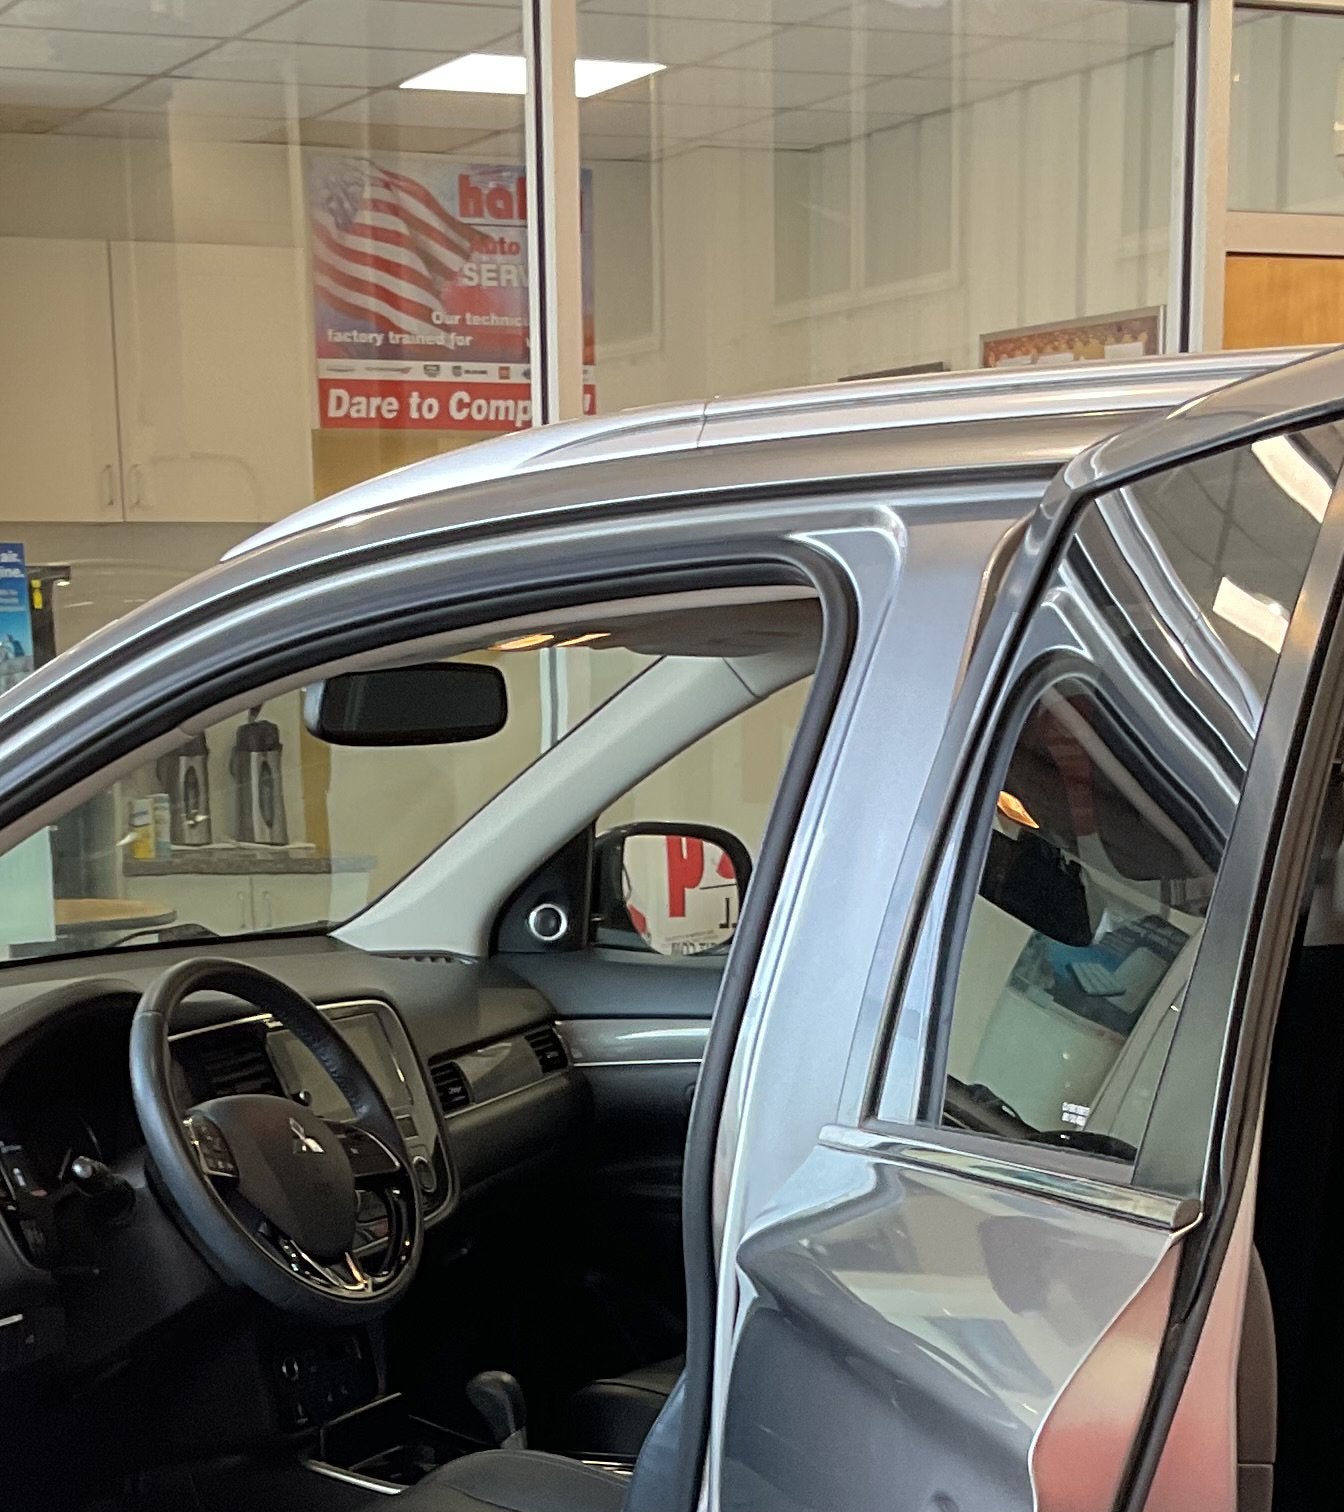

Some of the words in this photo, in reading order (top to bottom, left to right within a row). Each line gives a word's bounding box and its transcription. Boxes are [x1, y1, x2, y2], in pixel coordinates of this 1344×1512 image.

[458, 172, 527, 220] hal
[462, 263, 529, 287] SERV
[431, 311, 461, 325] Our
[327, 328, 384, 346] factory
[388, 330, 446, 345] trained
[449, 332, 474, 346] for
[327, 388, 399, 419] Dare
[409, 391, 440, 420] to
[448, 389, 533, 427] Comp
